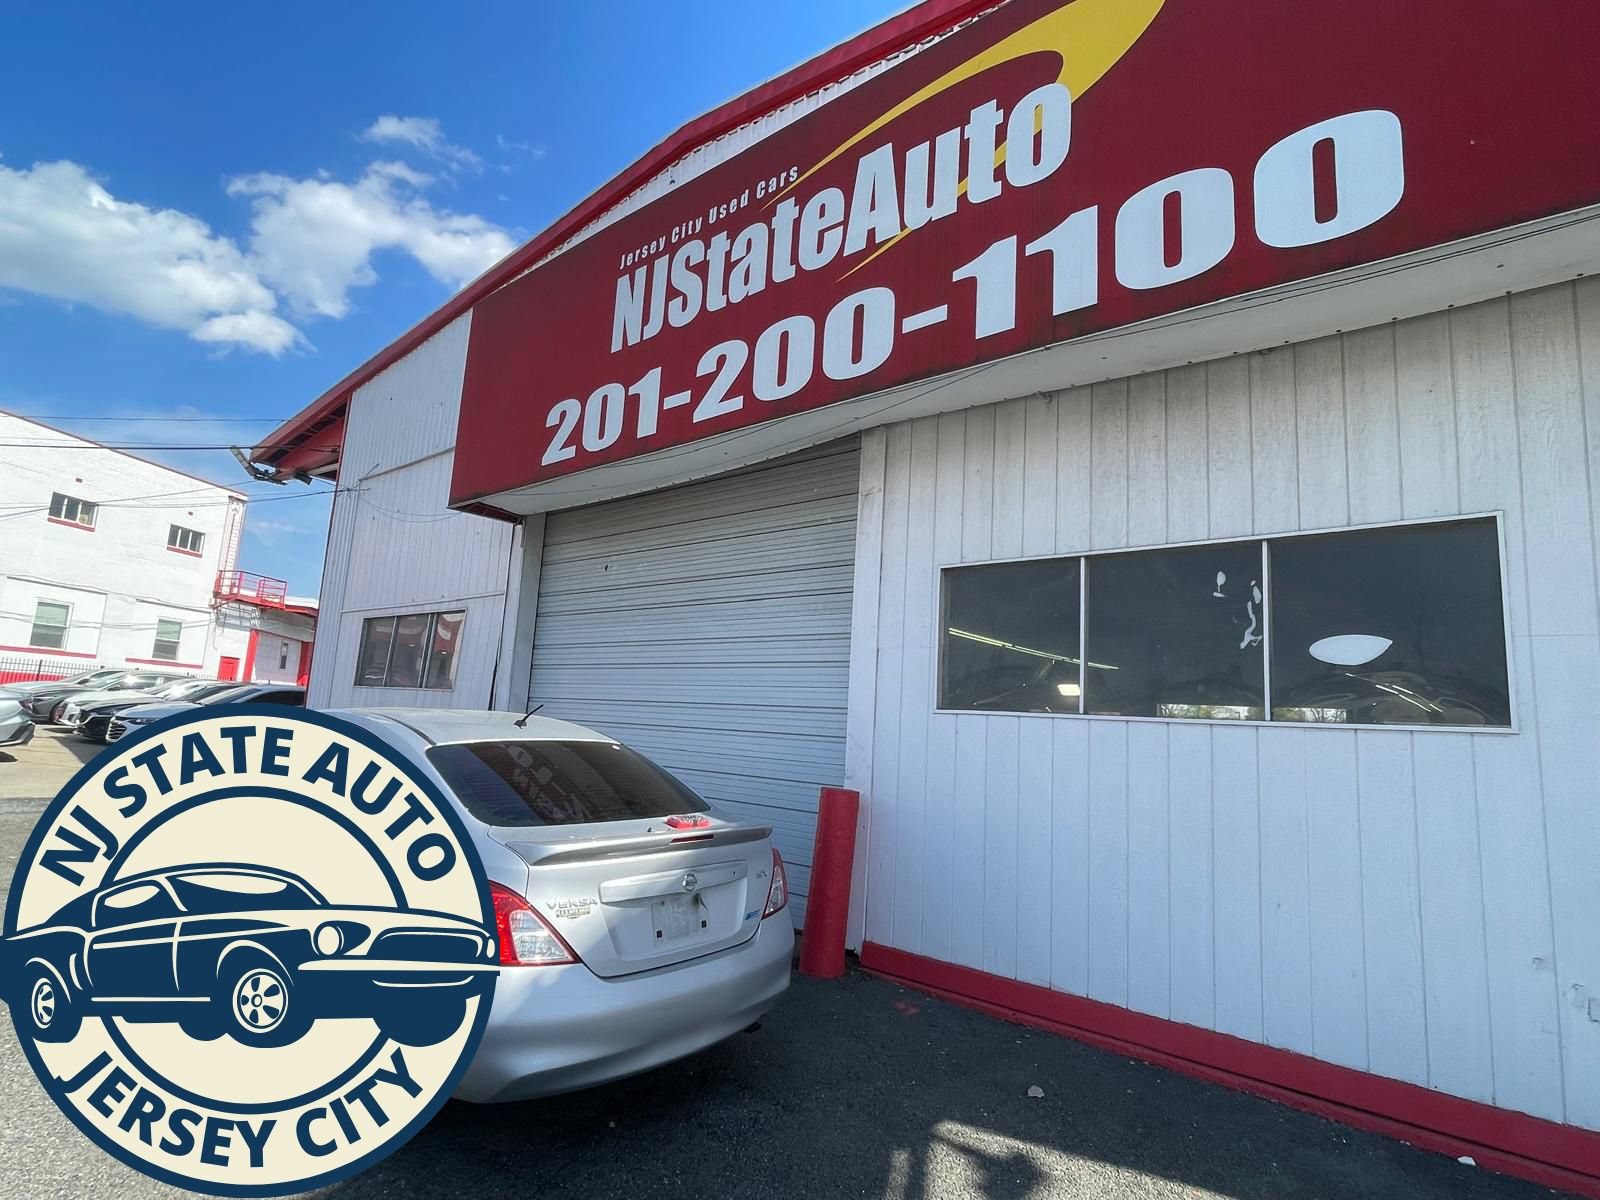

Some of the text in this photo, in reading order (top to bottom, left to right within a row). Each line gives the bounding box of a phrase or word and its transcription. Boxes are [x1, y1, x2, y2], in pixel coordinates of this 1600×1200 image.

[541, 109, 1405, 466] 201-200-1100
[610, 83, 1072, 354] NJStateAuto
[620, 165, 799, 269] Jersey City Used Cars
[545, 897, 599, 909] VERSA
